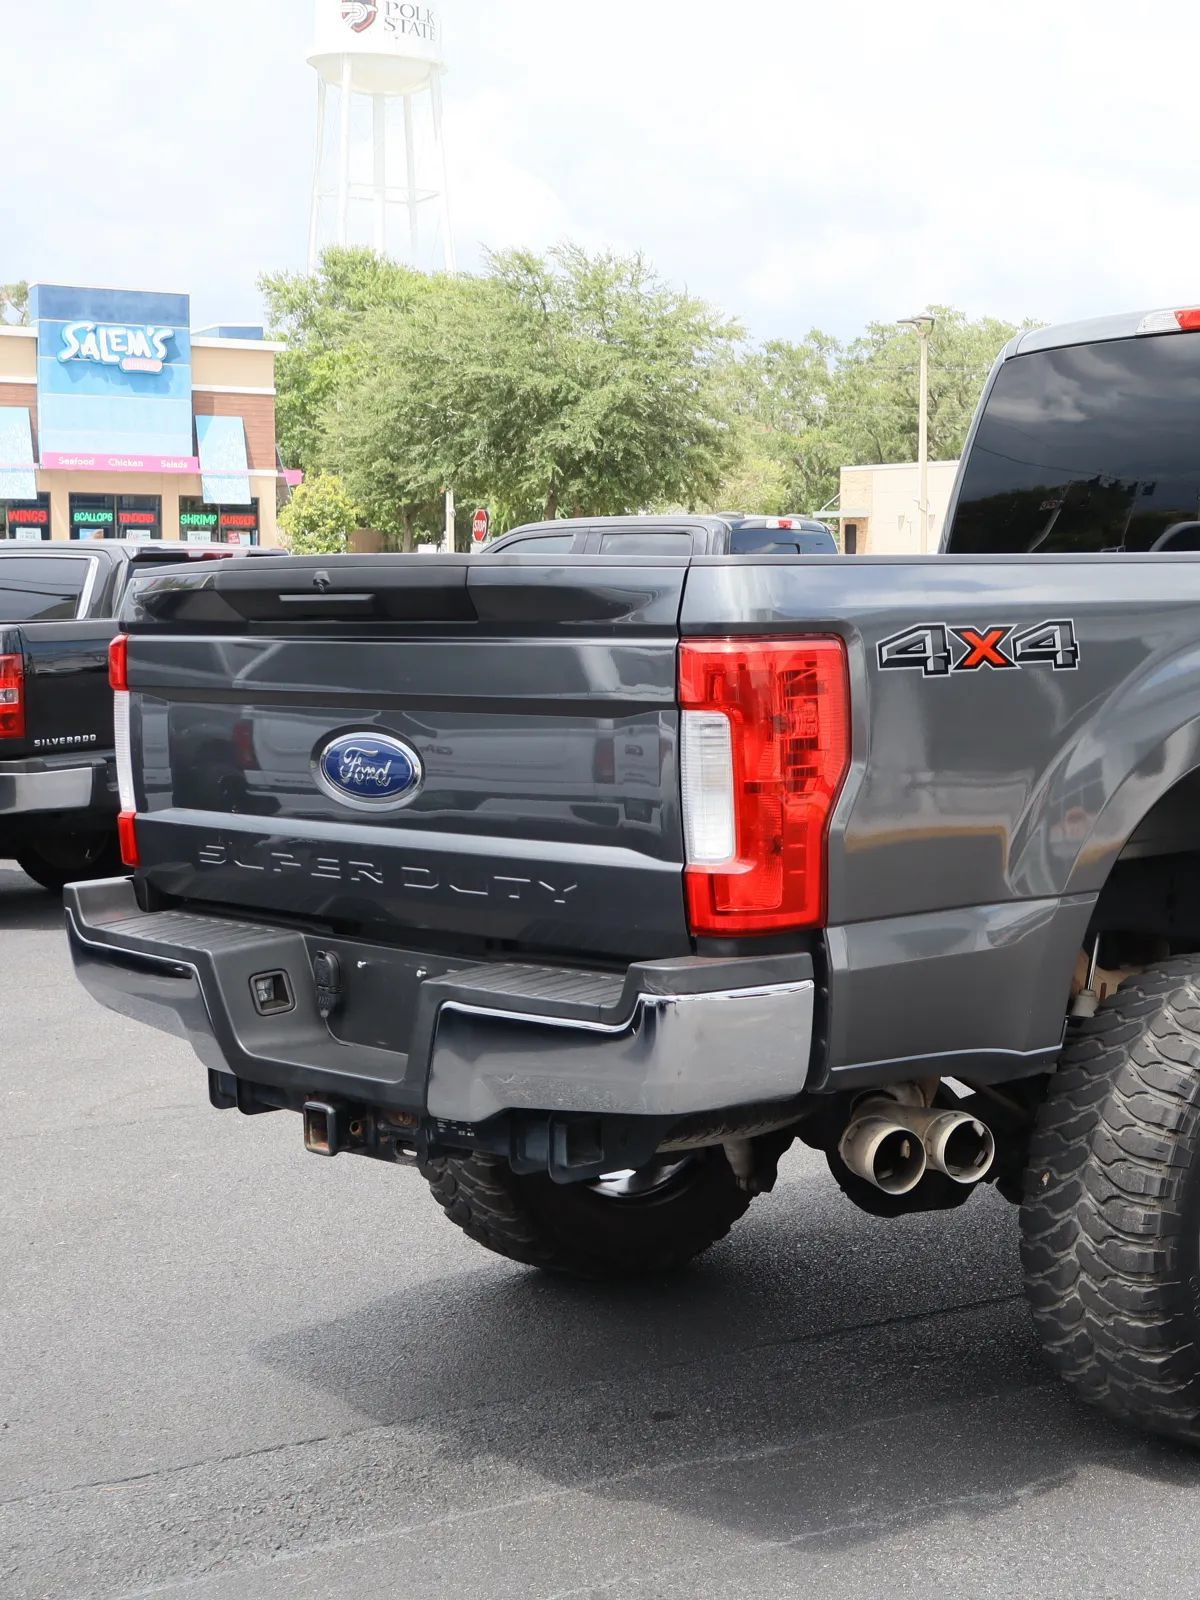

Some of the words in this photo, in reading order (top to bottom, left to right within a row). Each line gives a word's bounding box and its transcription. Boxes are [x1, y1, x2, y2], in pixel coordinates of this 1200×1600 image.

[385, 1, 435, 26] POLK
[384, 17, 436, 41] STATE
[60, 321, 174, 362] SALEM'S
[108, 457, 144, 467] Chicken
[8, 509, 48, 523] WINGS
[73, 512, 113, 522] SCALLOPS
[180, 514, 217, 526] SHRIMP
[34, 734, 97, 747] SILVERADO
[340, 747, 392, 787] Ford
[402, 866, 578, 903] DUTY
